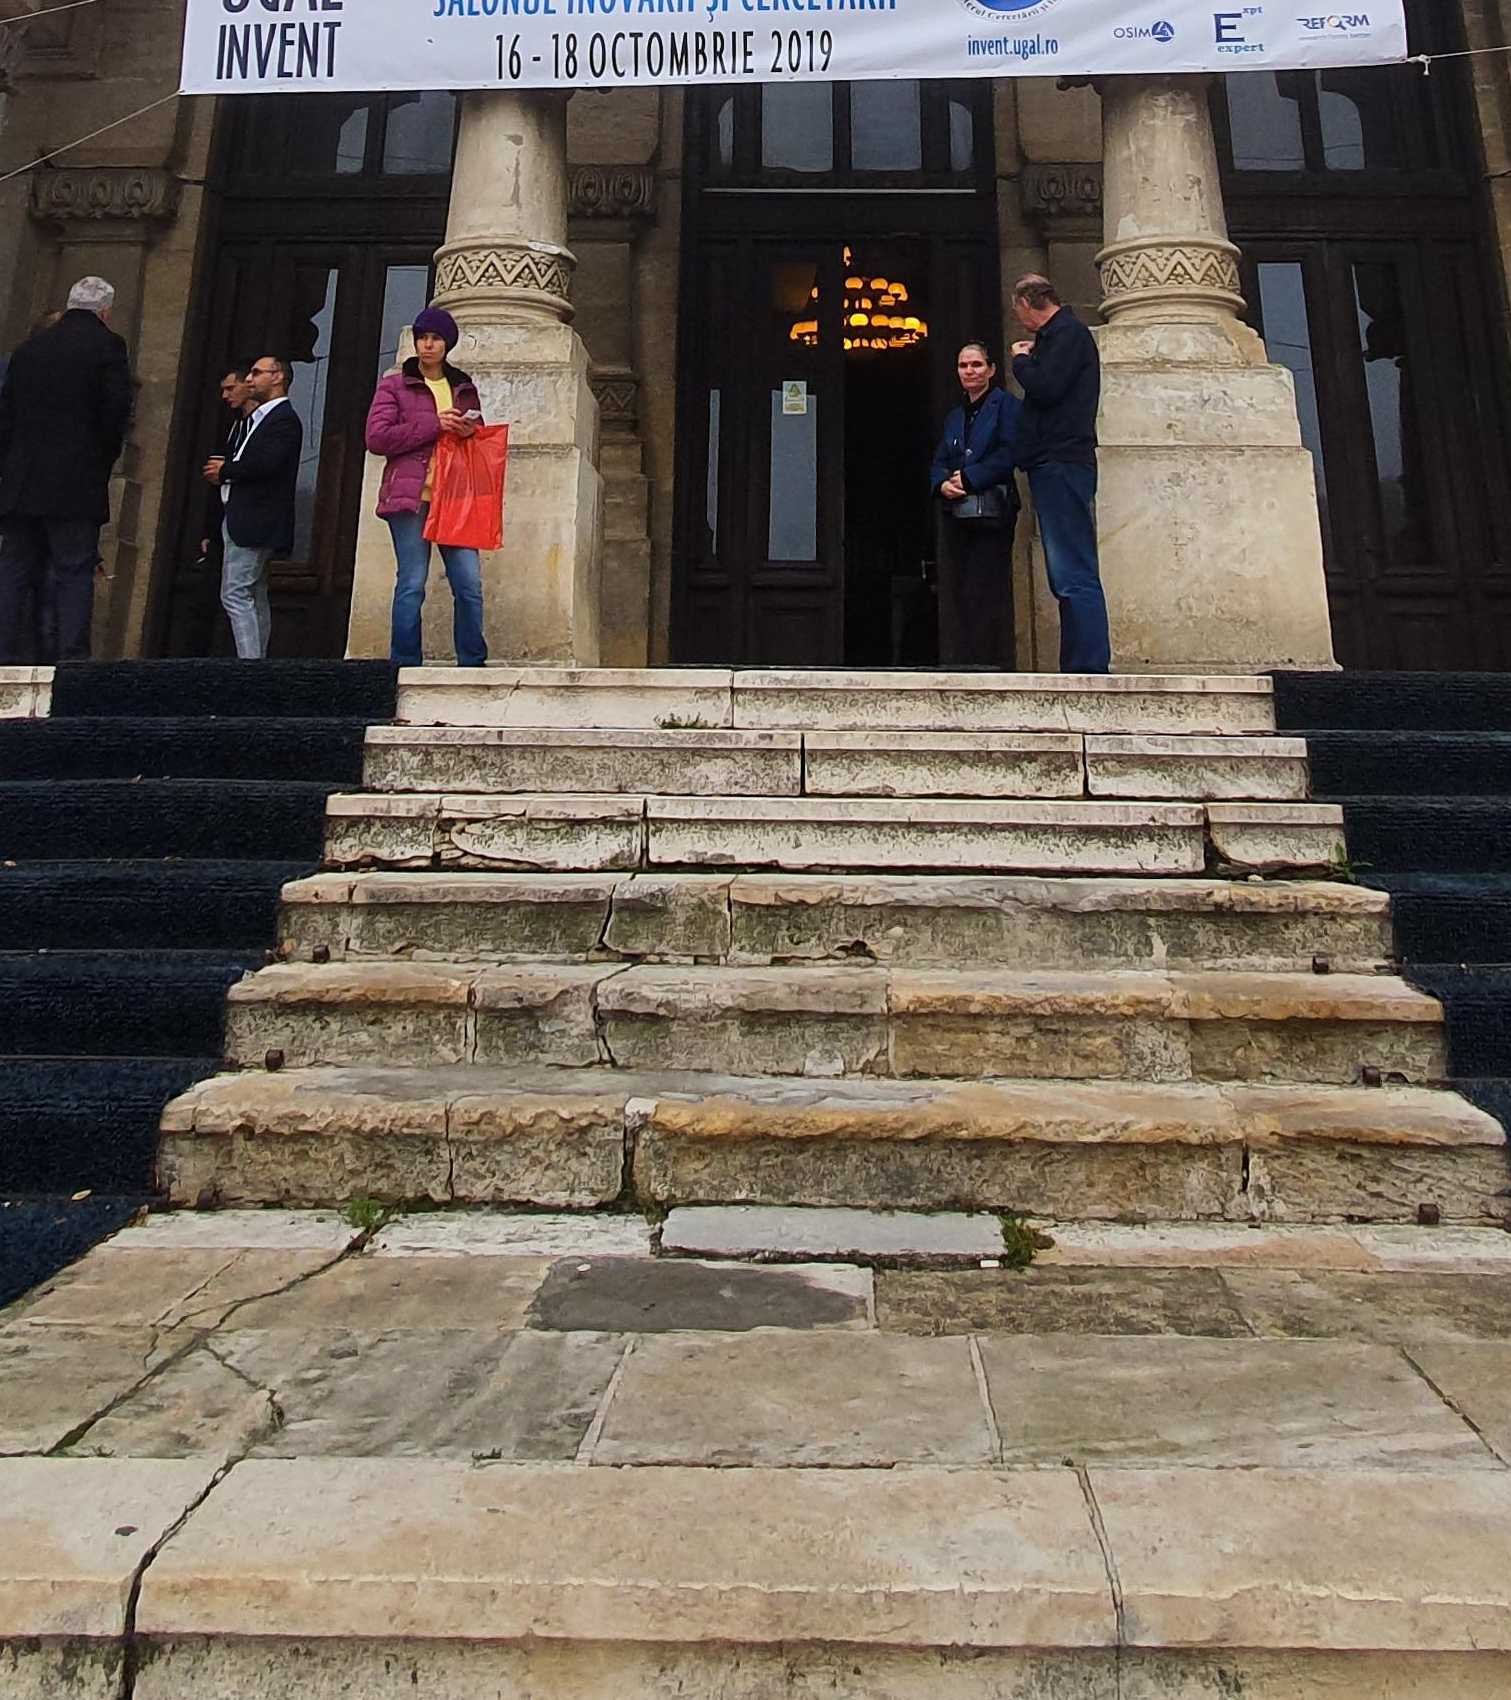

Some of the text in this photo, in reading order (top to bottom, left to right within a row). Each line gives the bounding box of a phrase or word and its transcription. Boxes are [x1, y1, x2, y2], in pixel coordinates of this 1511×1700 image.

[1113, 26, 1151, 39] OSIM
[216, 21, 342, 80] INVENT
[496, 33, 522, 80] 16
[552, 33, 578, 79] 18
[589, 31, 754, 77] OCTOMBRIE
[770, 29, 833, 74] 2019
[967, 34, 1059, 60] invent.ugal.ro
[1217, 43, 1265, 54] expert
